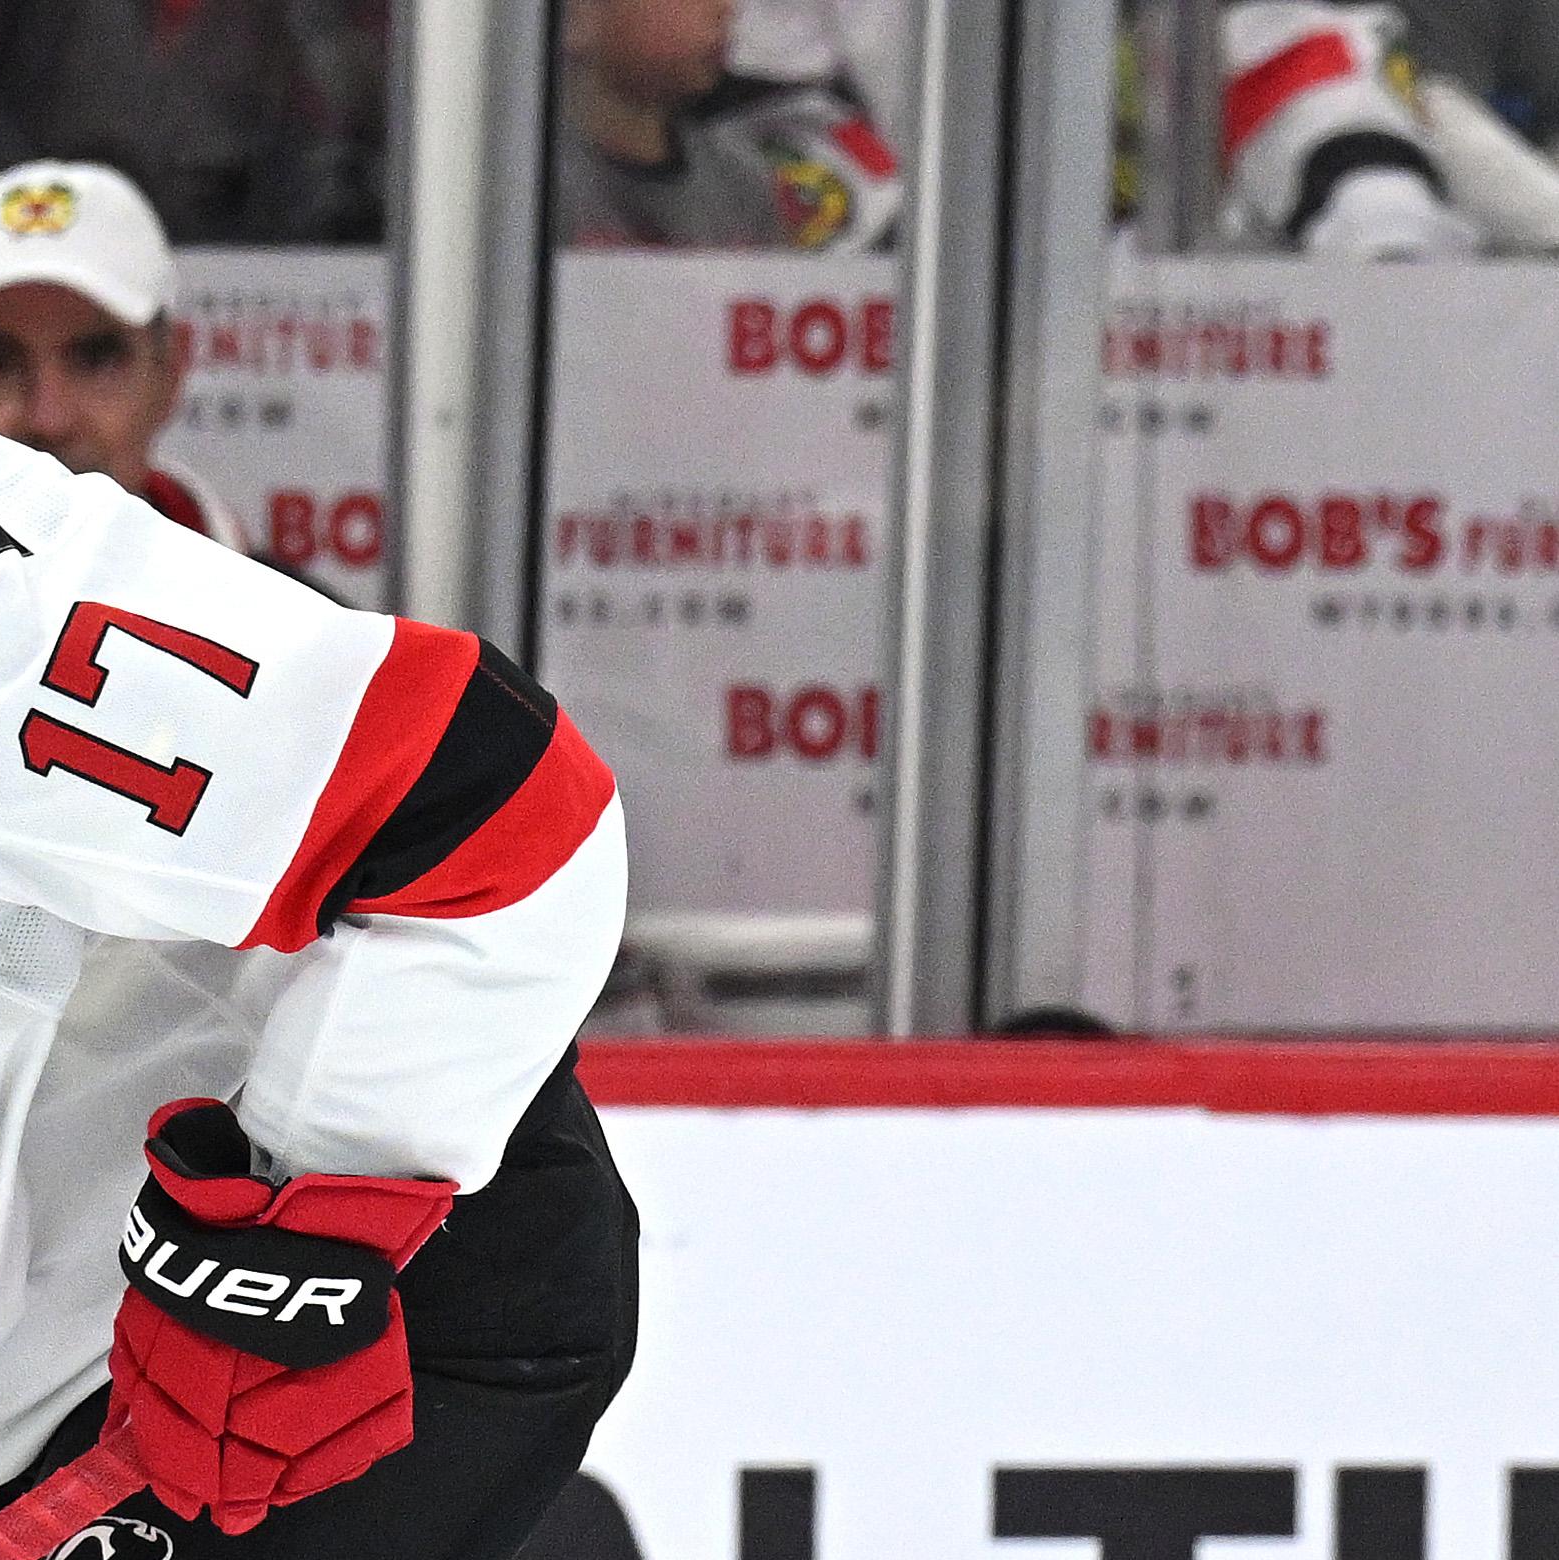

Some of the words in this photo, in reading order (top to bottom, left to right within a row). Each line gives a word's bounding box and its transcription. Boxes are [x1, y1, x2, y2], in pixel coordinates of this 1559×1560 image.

[1190, 497, 1443, 571] BOB'S
[19, 600, 260, 838] 17
[121, 1205, 363, 1326] AUER
